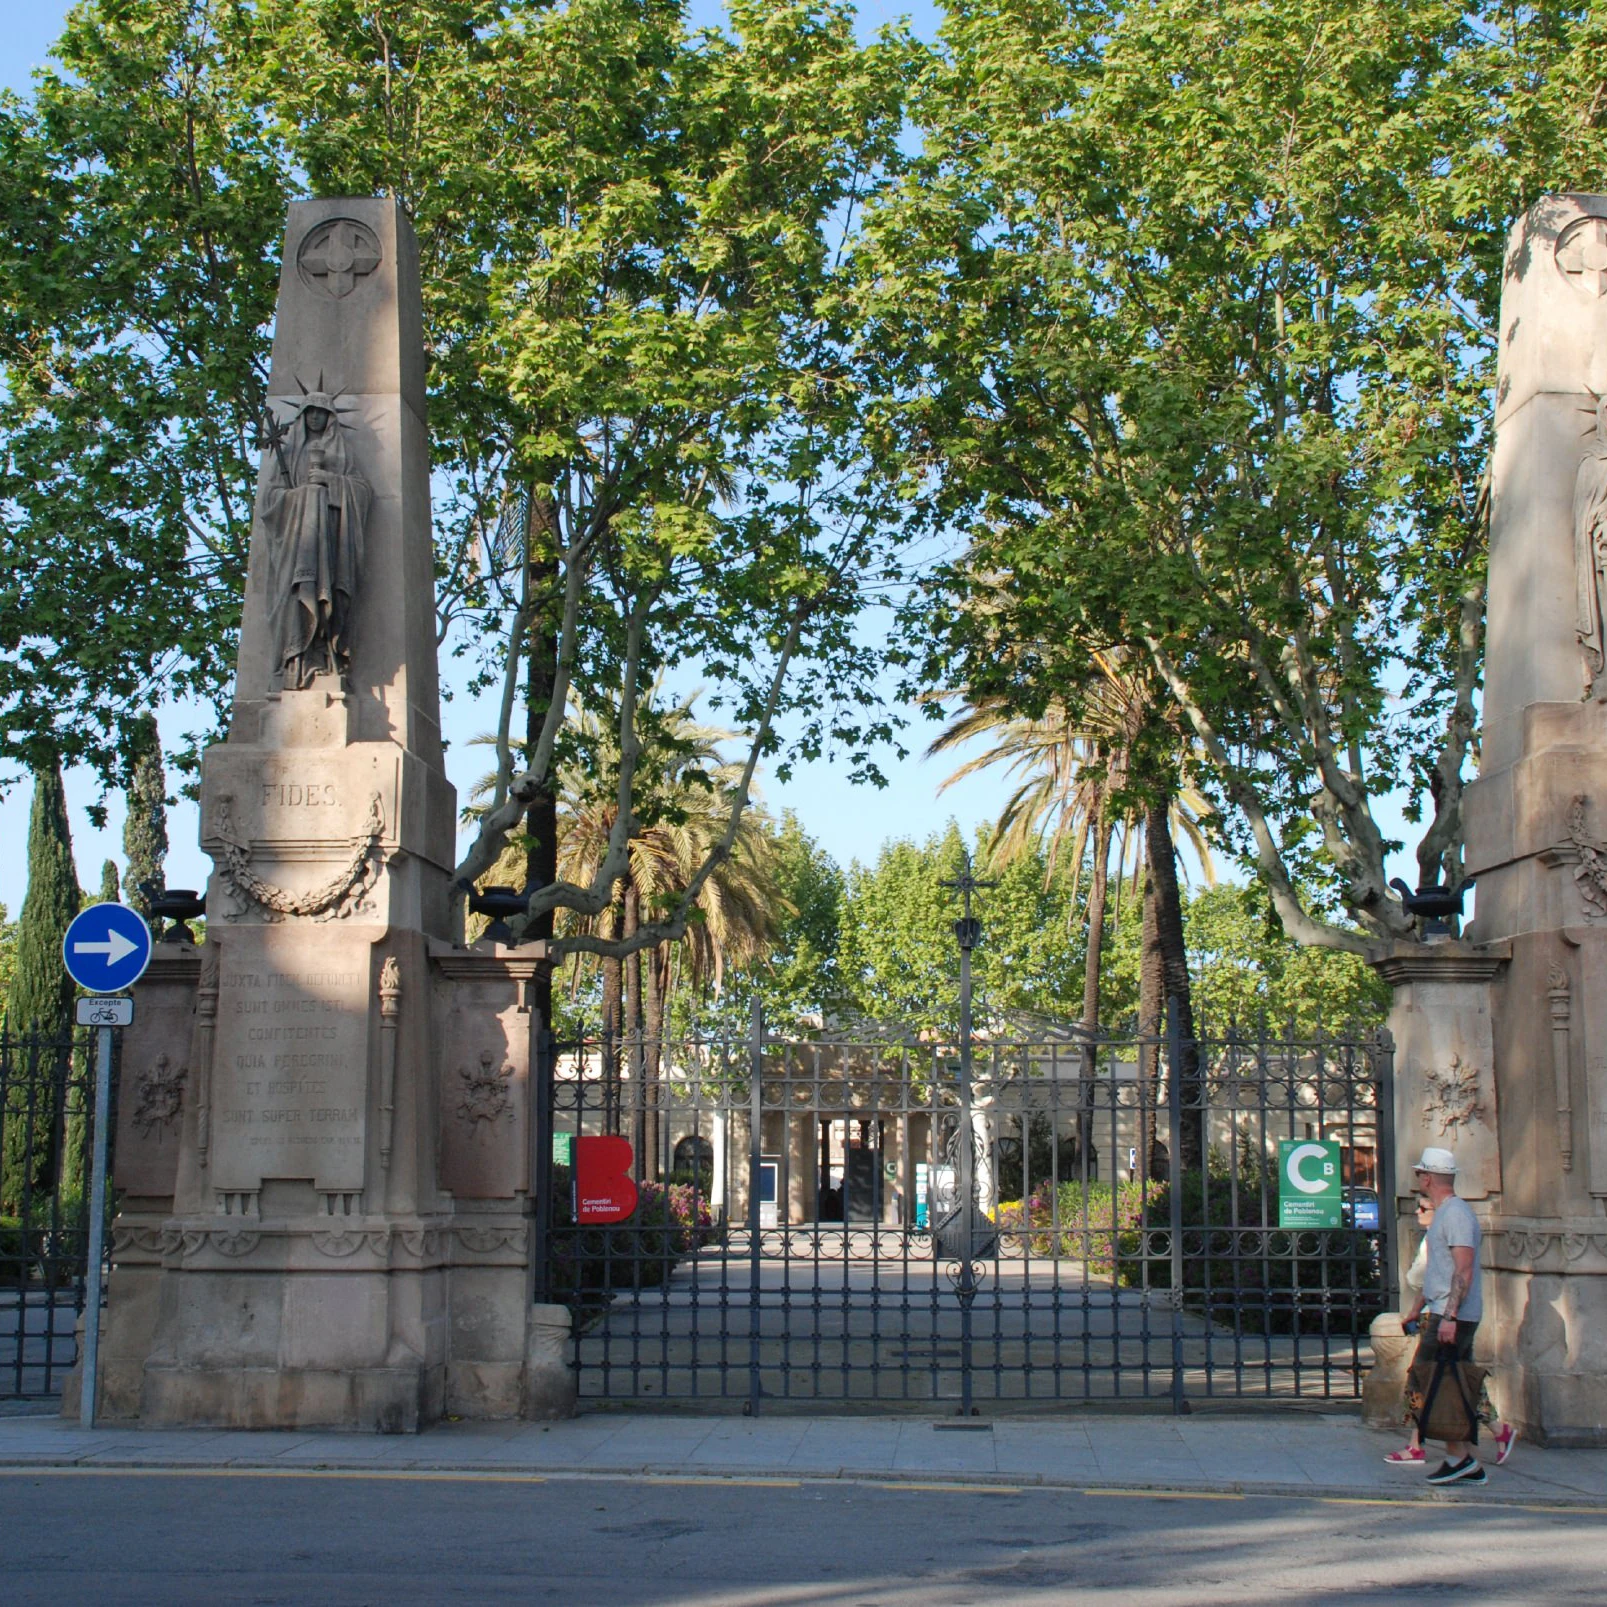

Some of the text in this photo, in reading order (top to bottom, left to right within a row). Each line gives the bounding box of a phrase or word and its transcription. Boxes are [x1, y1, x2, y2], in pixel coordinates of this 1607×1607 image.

[88, 998, 122, 1007] Excepte
[262, 1109, 301, 1123] SUPER
[1287, 1144, 1335, 1194] C B
